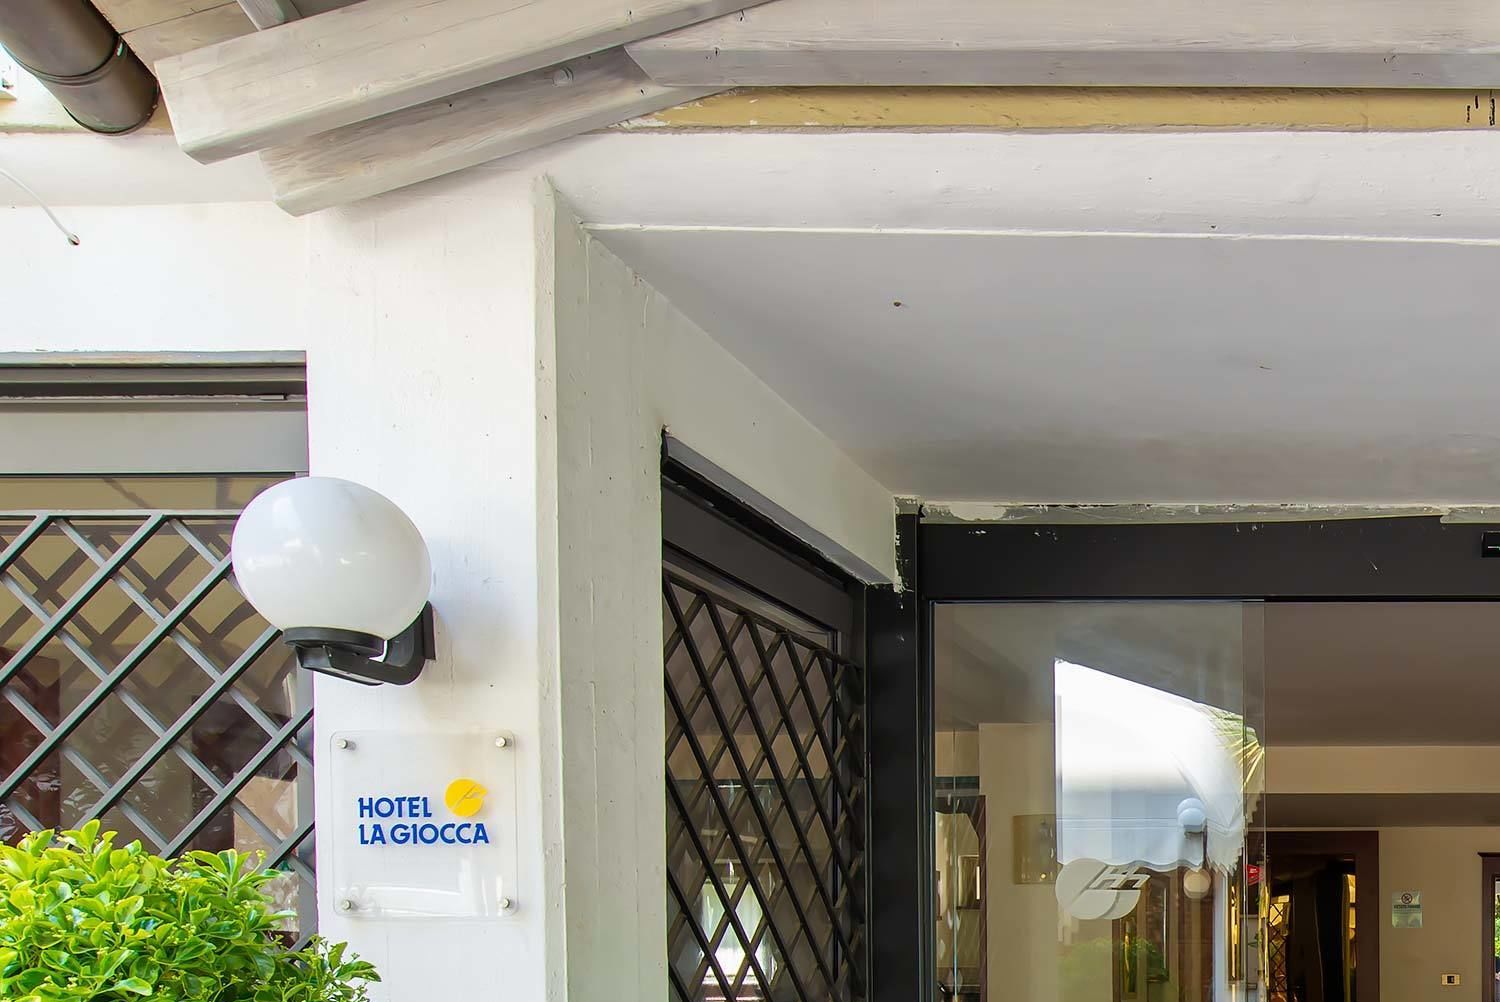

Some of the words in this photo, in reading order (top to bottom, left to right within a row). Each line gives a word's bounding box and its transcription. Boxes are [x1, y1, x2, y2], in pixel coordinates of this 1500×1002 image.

[358, 796, 432, 818] HOTEL
[359, 823, 386, 845] LA
[390, 823, 489, 845] GIOCCA
